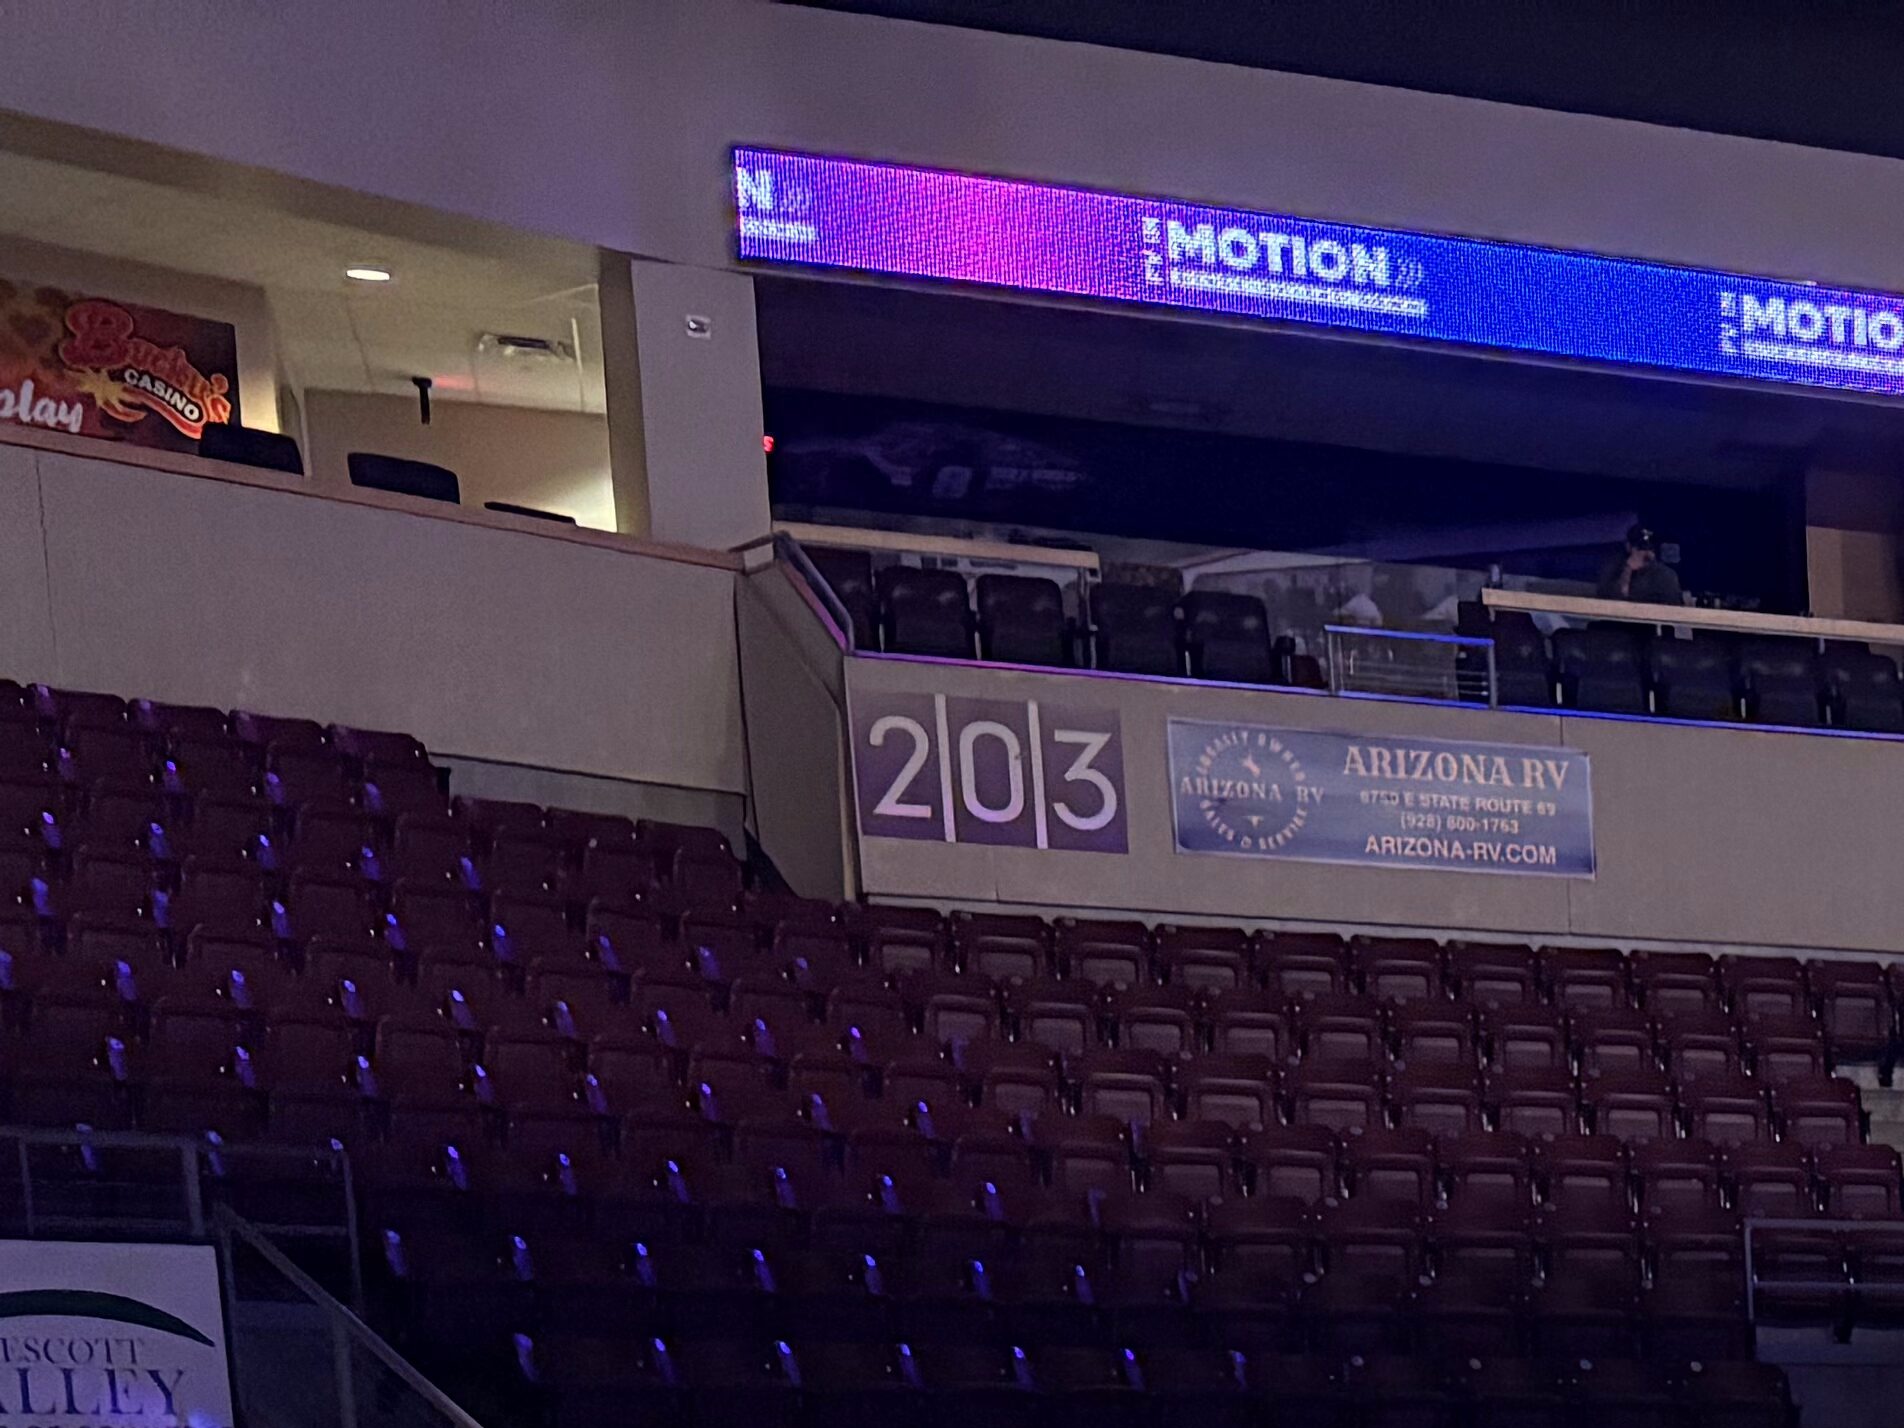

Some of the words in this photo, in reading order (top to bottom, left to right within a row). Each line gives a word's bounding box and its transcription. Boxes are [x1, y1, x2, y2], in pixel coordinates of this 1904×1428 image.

[1166, 220, 1392, 287] MOTION
[123, 367, 201, 421] CASINO
[868, 714, 1120, 832] 203
[1180, 775, 1283, 802] ARIZONA
[1294, 785, 1325, 806] RV
[1343, 744, 1512, 788] ARIZONA
[1521, 759, 1570, 791] RV
[1403, 792, 1415, 808] E
[1418, 793, 1470, 812] STATE
[1474, 796, 1532, 815] ROUTE
[1364, 834, 1557, 866] ARIZONA-RV.COM
